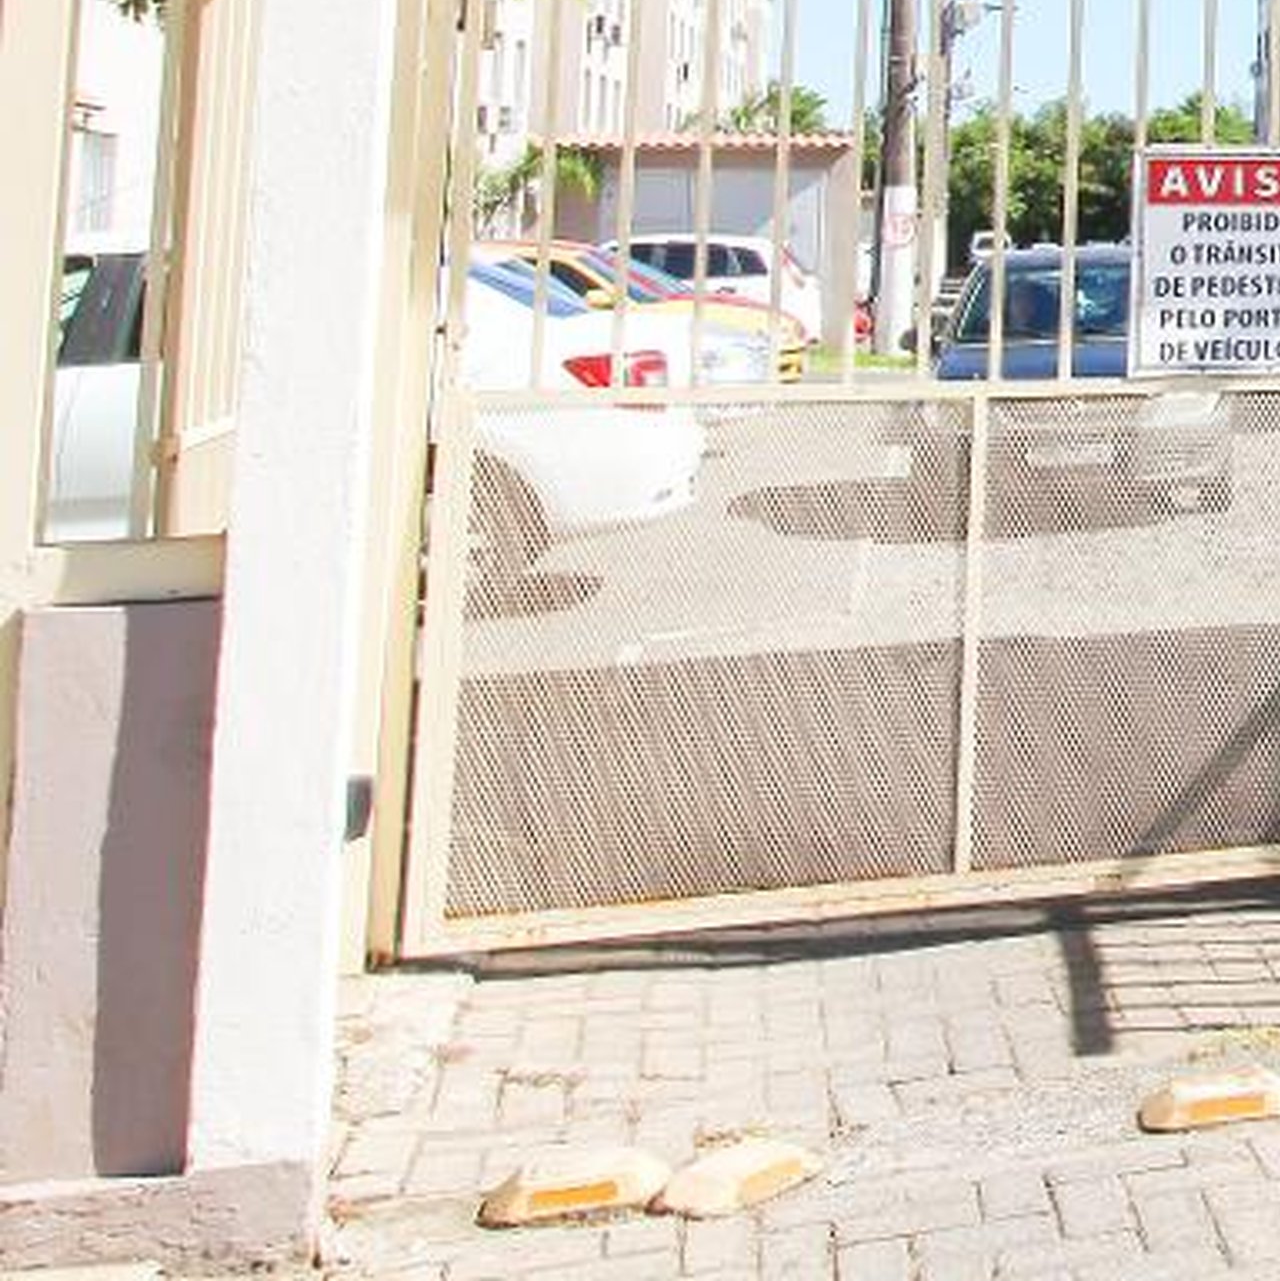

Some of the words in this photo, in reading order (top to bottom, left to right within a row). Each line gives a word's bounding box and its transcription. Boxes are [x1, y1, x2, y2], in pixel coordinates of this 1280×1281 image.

[1170, 245, 1186, 264] O
[1154, 277, 1184, 297] DE
[1160, 309, 1214, 328] PELO
[1160, 342, 1187, 362] DE
